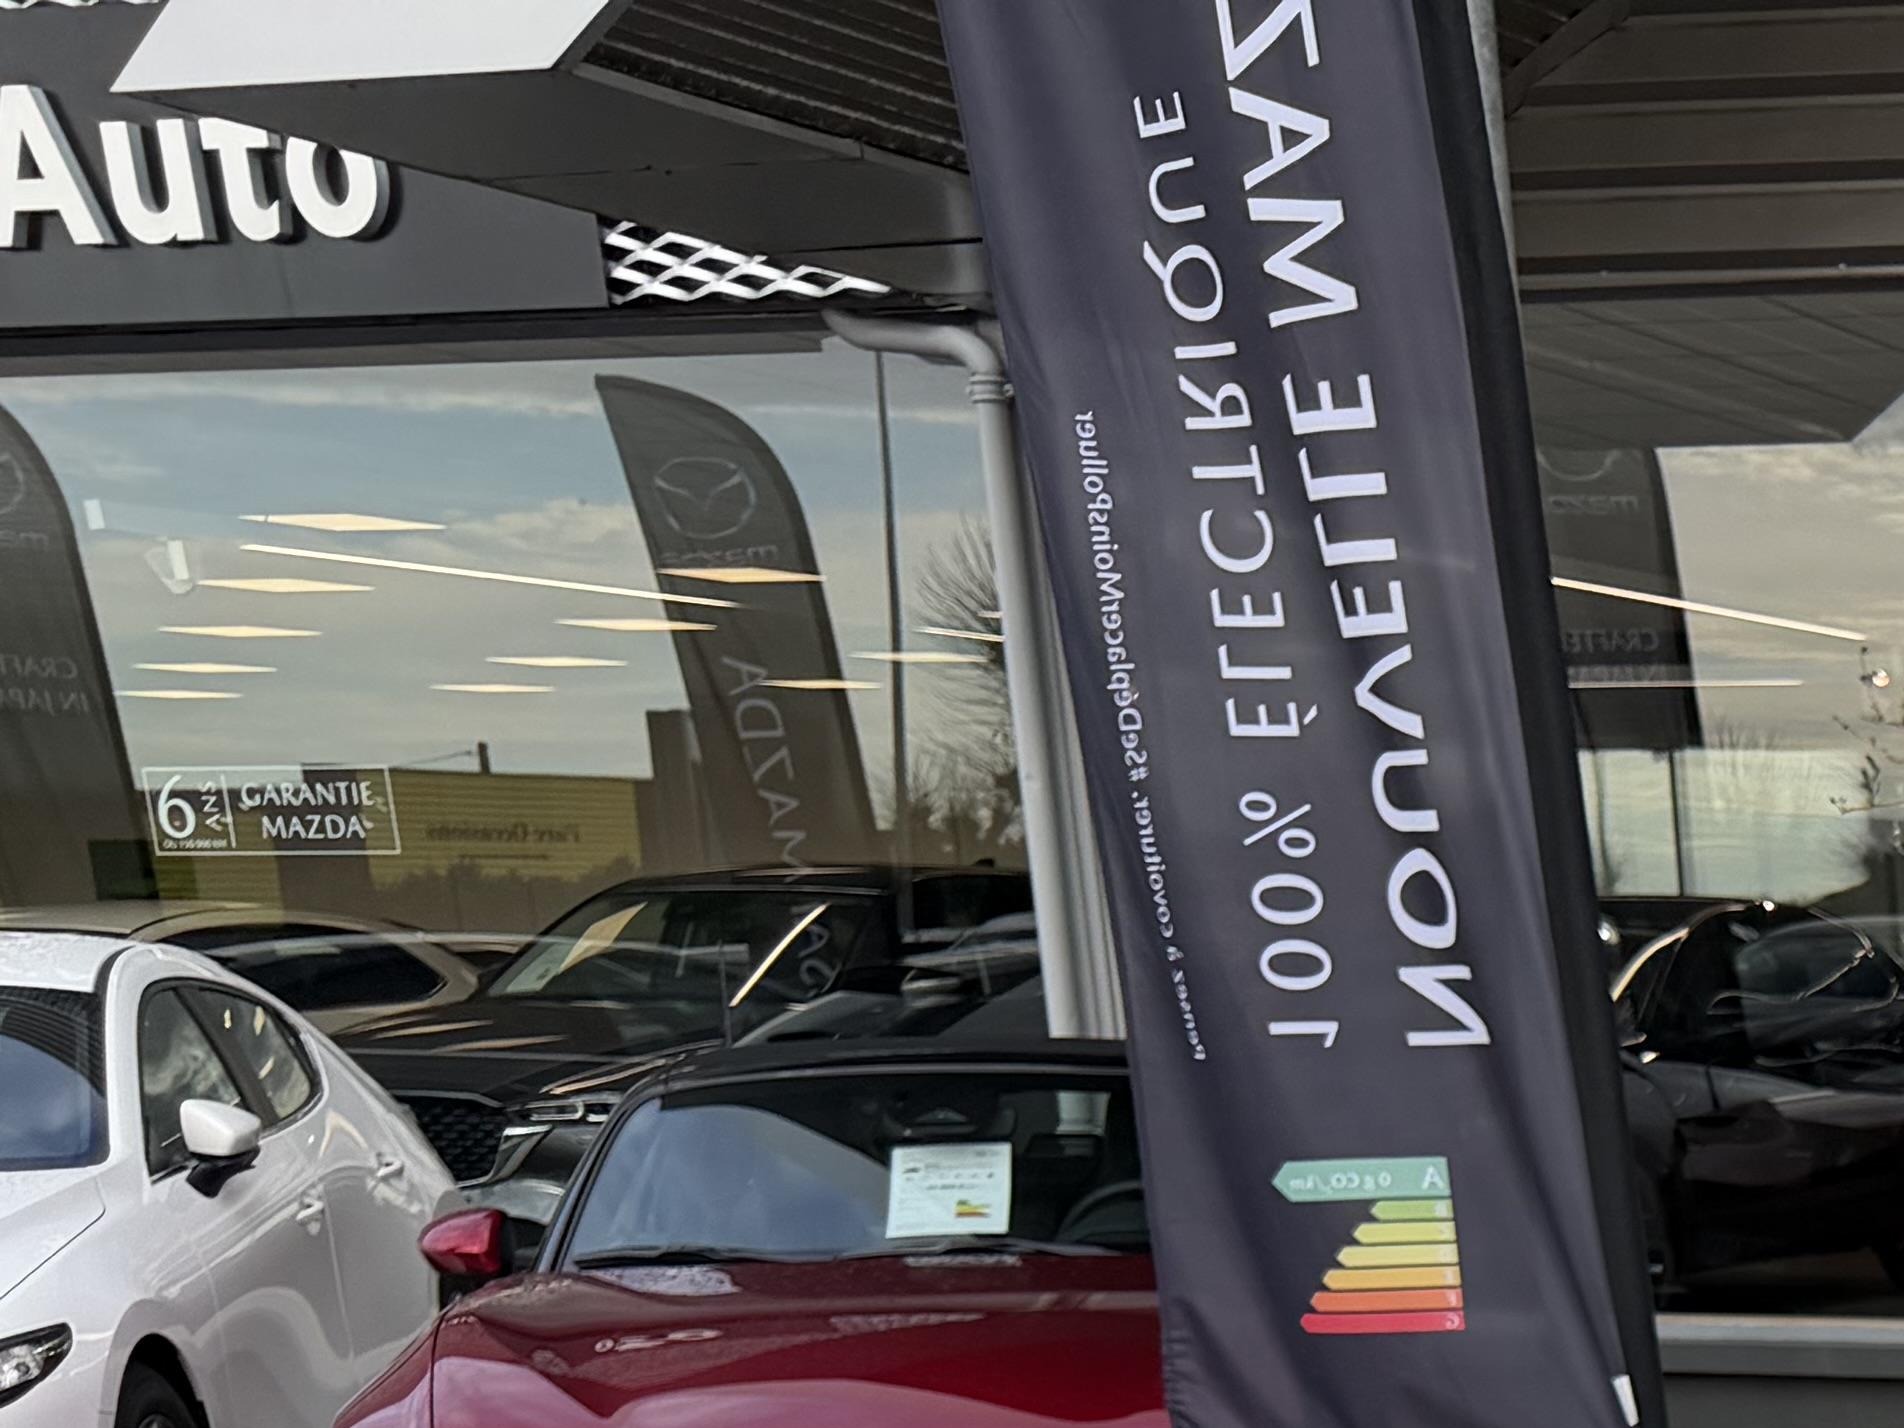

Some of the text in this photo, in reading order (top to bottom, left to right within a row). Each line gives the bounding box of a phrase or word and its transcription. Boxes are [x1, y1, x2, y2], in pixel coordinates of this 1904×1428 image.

[0, 84, 390, 250] Auto
[158, 774, 197, 840] 6
[240, 780, 377, 807] GARANTIE
[261, 814, 367, 840] MAZDA
